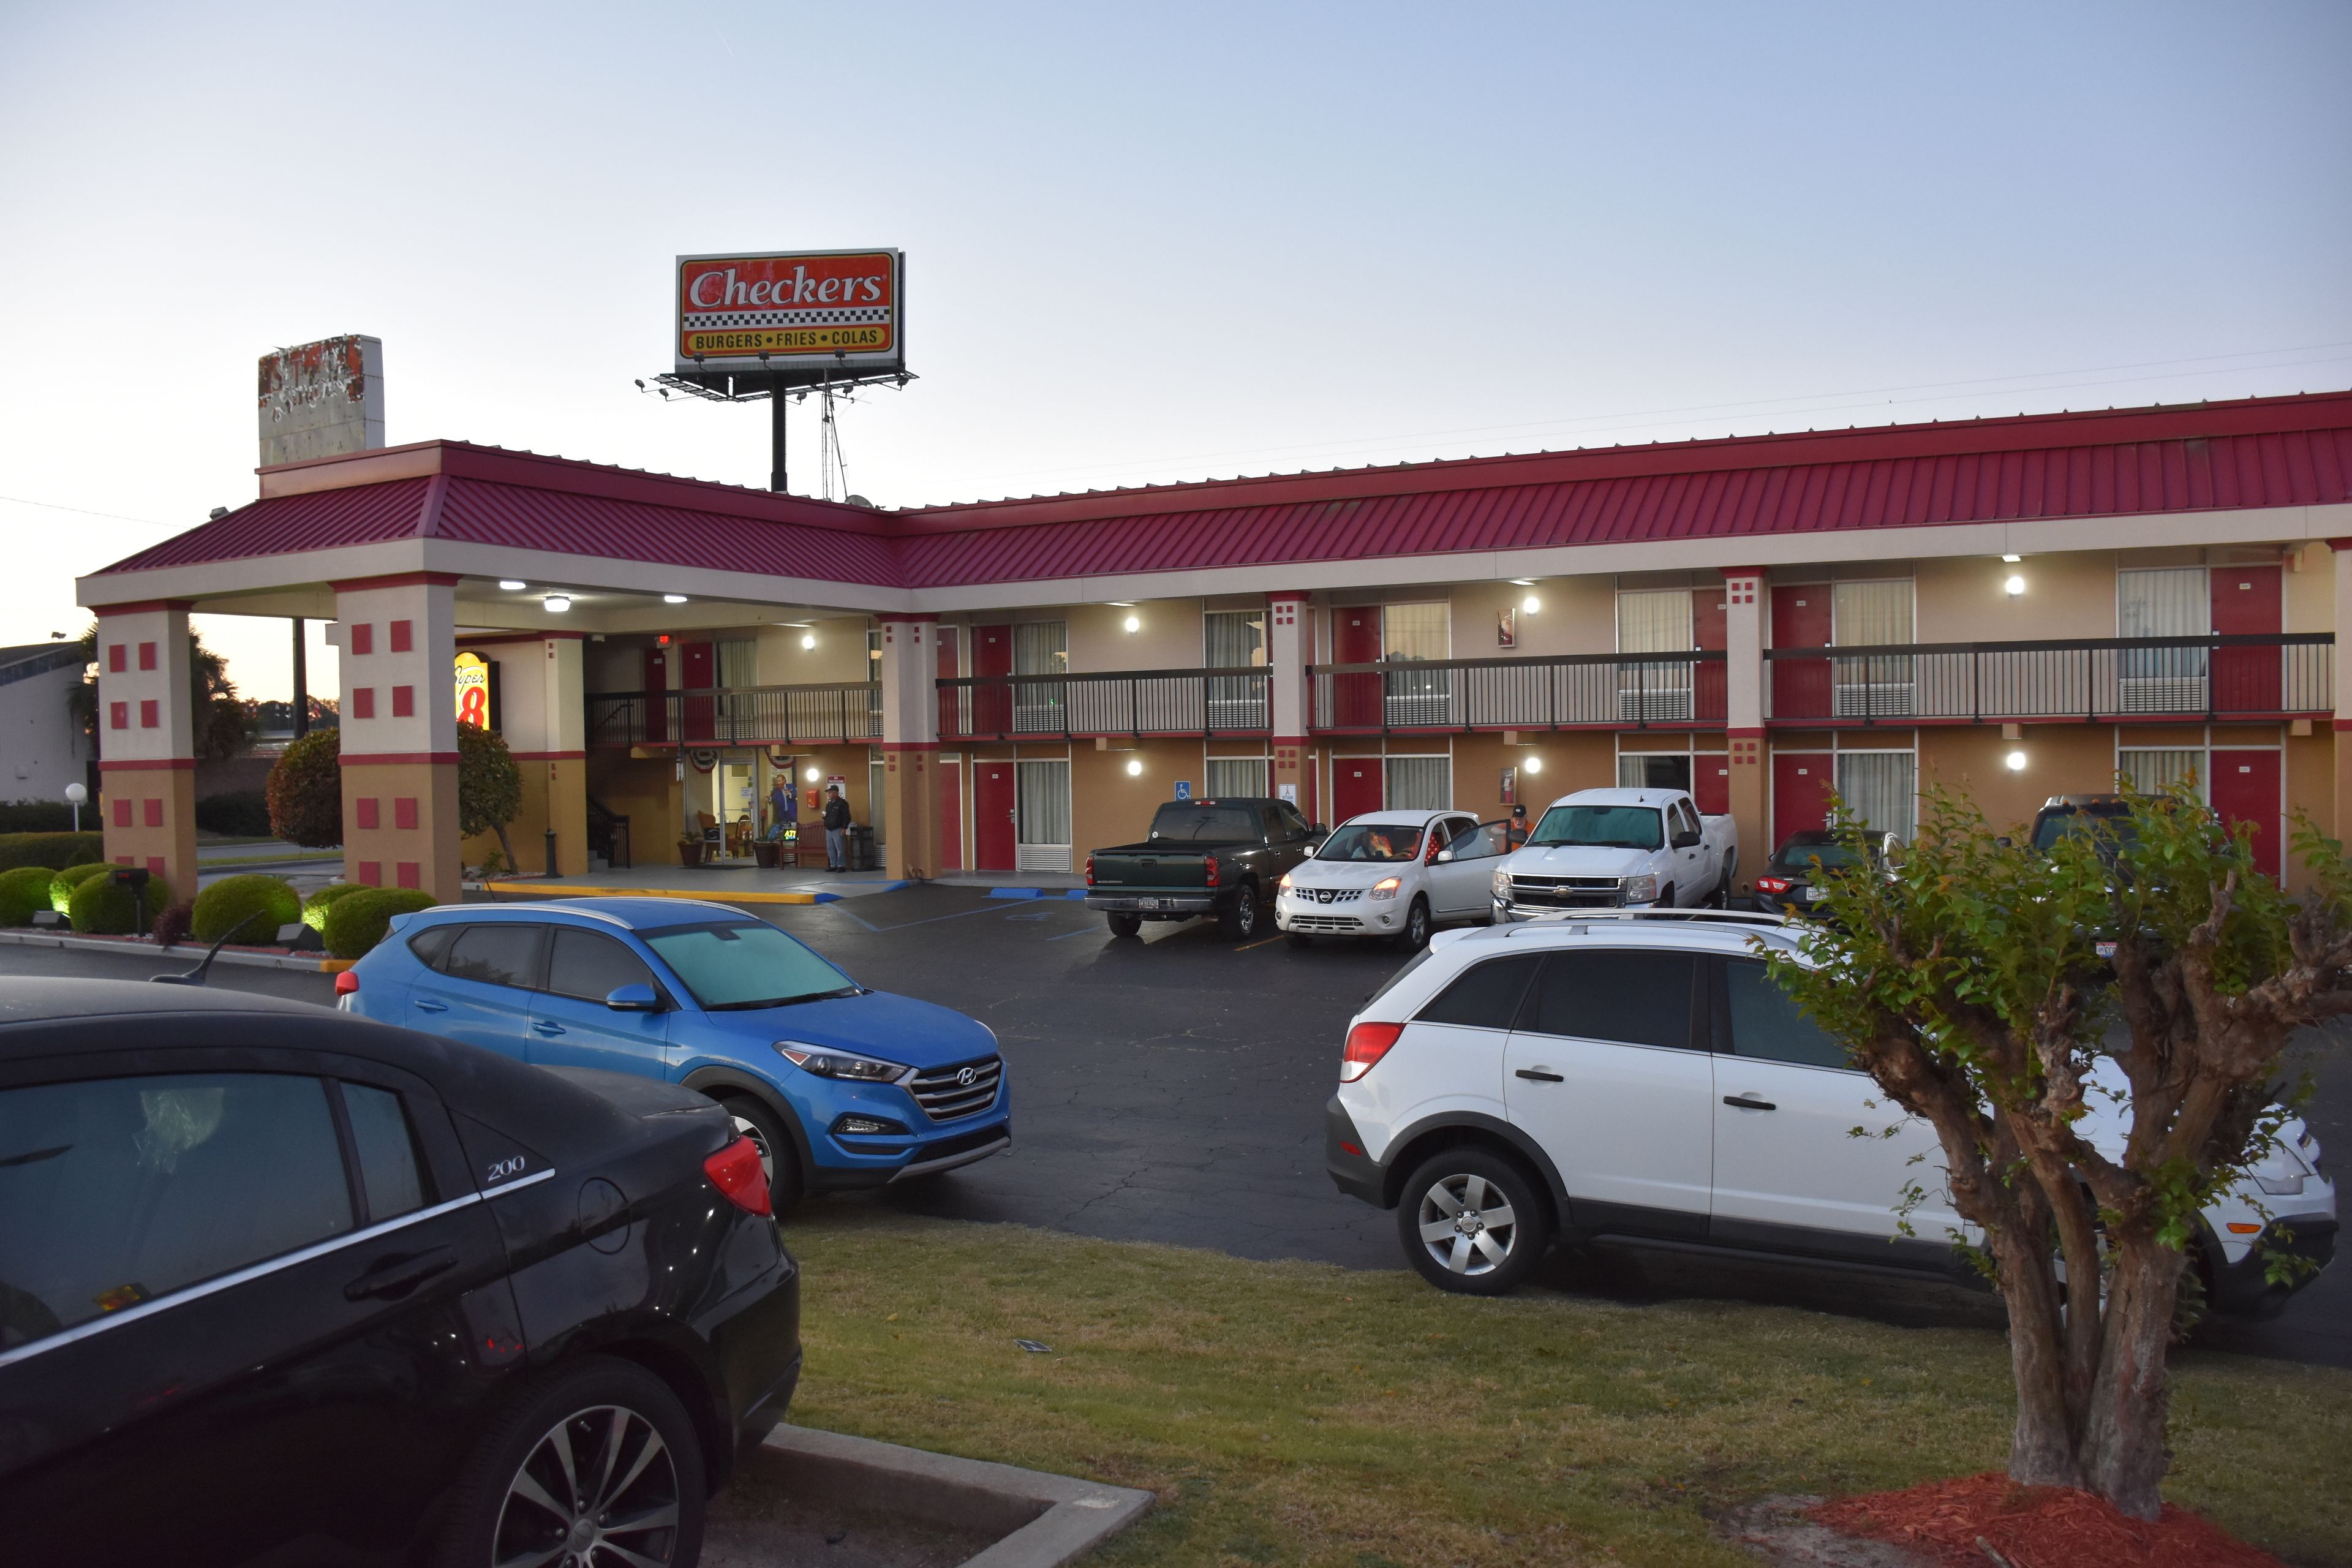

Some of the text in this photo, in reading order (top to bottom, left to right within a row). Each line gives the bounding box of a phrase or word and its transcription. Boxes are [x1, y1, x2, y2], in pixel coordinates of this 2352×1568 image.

[689, 265, 883, 307] Checkers
[696, 330, 877, 349] BURGERS FRIES COLAS
[488, 1155, 525, 1182] 200
